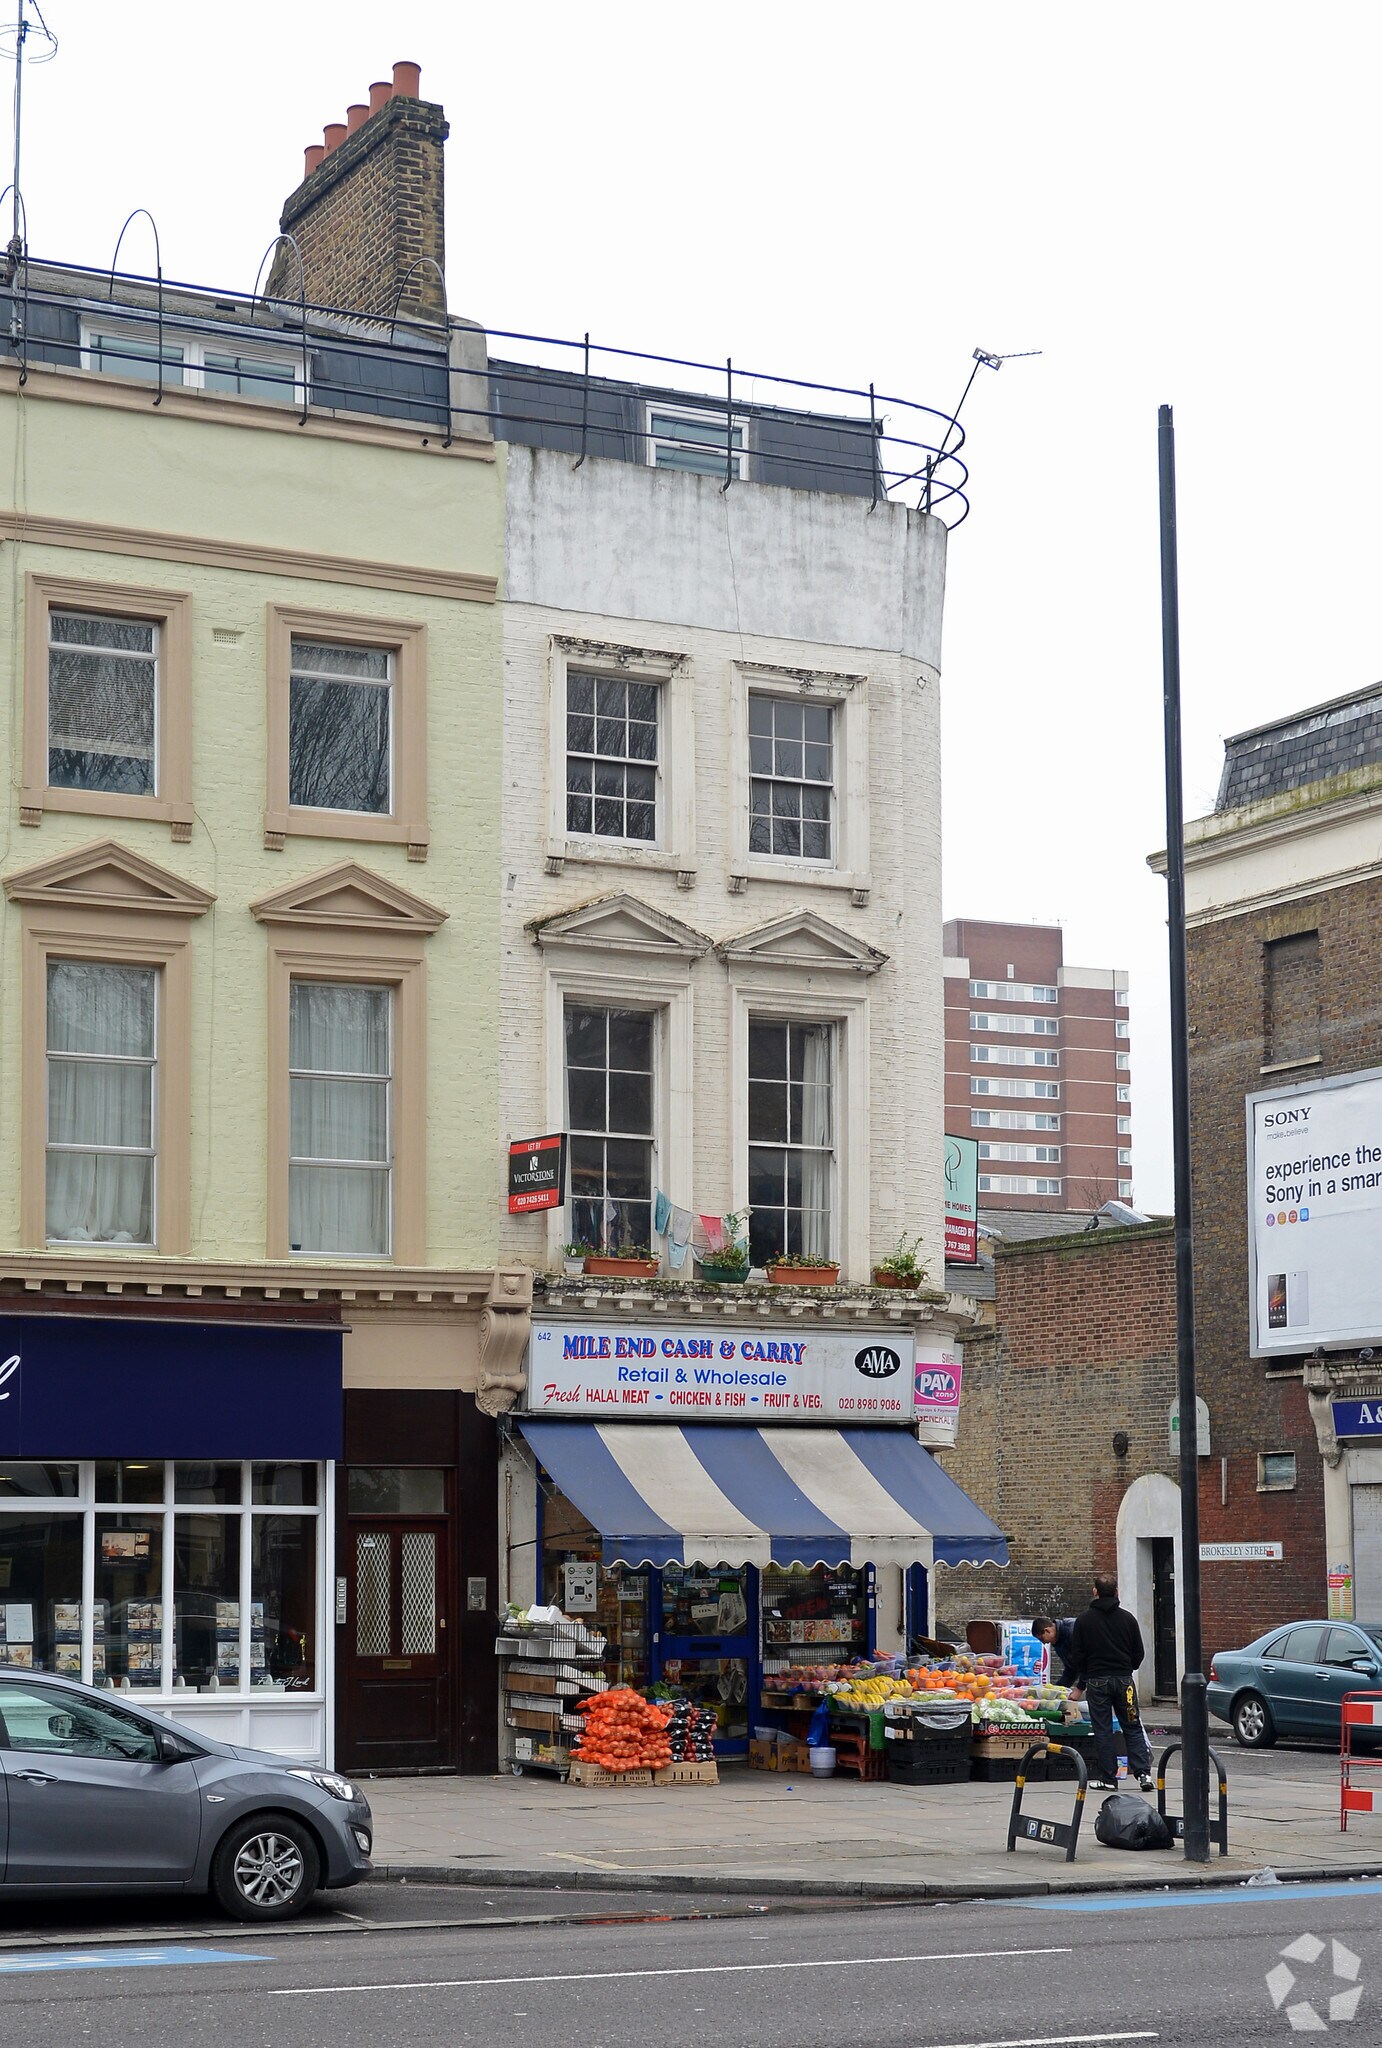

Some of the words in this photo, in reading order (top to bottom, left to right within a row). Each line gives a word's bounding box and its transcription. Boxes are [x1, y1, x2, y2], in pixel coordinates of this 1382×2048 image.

[1264, 1107, 1312, 1128] SONY
[527, 1142, 535, 1151] LET
[1265, 1154, 1351, 1181] experience
[1355, 1145, 1382, 1165] the
[513, 1169, 554, 1183] VICTORSTONE
[1265, 1183, 1304, 1203] Sony
[1308, 1178, 1322, 1197] in
[1326, 1179, 1336, 1195] a
[952, 1202, 972, 1213] HOMES
[537, 1332, 552, 1341] 642
[562, 1334, 611, 1360] MILE
[614, 1336, 657, 1359] END
[661, 1338, 714, 1359] CASH
[719, 1340, 736, 1360] &
[741, 1341, 807, 1365] CARRY
[860, 1350, 896, 1374] AMA
[618, 1366, 669, 1383] Retail
[675, 1368, 688, 1383] &
[694, 1369, 787, 1386] Wholesale
[920, 1373, 951, 1393] PAY
[543, 1383, 581, 1406] Fresh
[586, 1388, 619, 1403] HALAL
[622, 1389, 650, 1404] MEAT
[669, 1391, 712, 1406] CHICKEN
[715, 1393, 722, 1406] &
[724, 1392, 746, 1407] FISH
[763, 1393, 791, 1408] FRUIT
[793, 1394, 800, 1408] &
[802, 1394, 823, 1409] VEG.
[838, 1398, 855, 1409] 020
[857, 1398, 878, 1410] 8980
[880, 1399, 901, 1411] 9086
[1201, 1546, 1243, 1556] BROKESLEY
[1245, 1545, 1273, 1556] STREET
[1029, 1822, 1036, 1835] P
